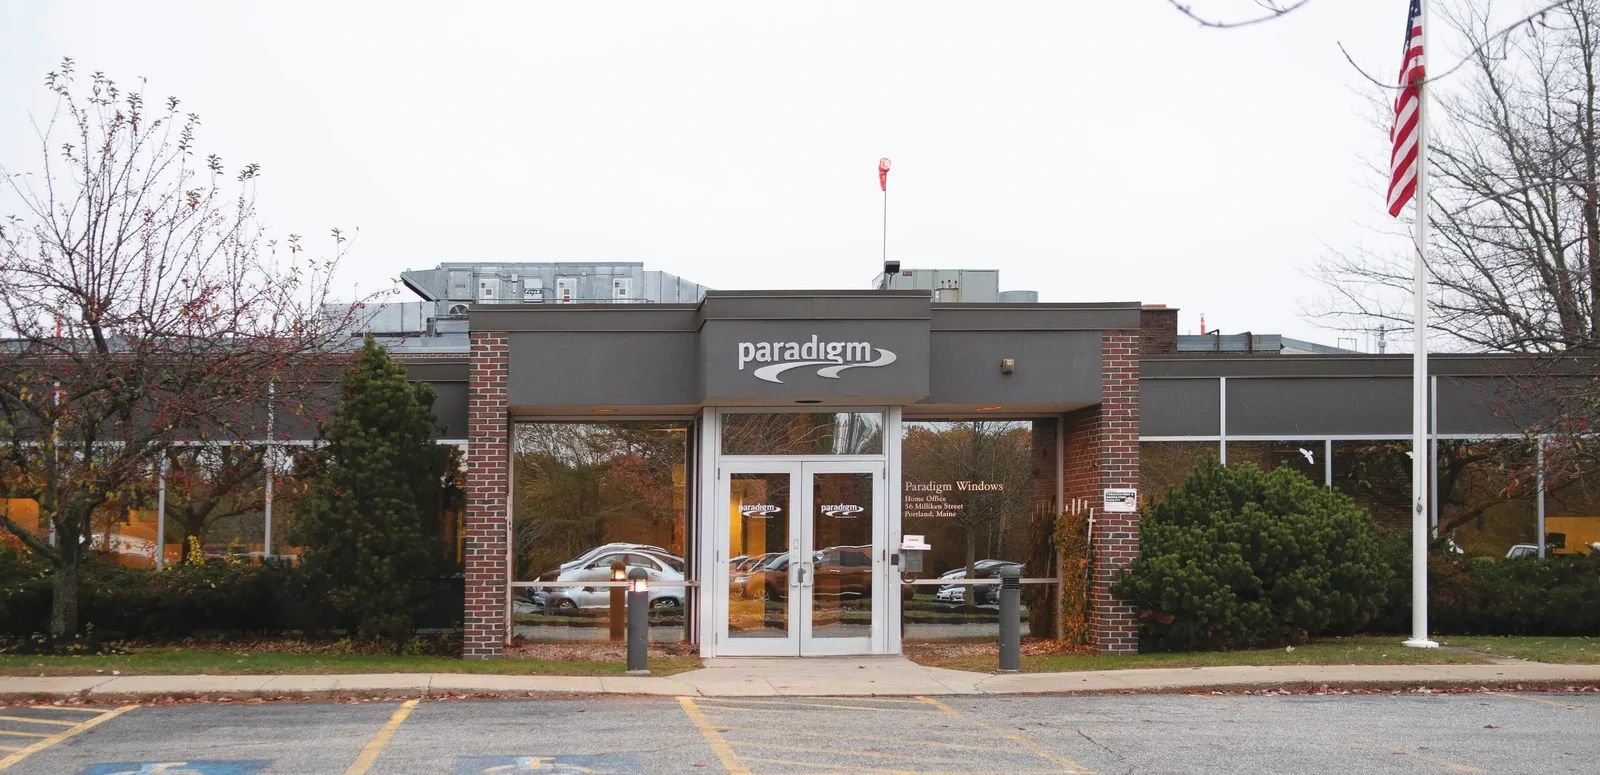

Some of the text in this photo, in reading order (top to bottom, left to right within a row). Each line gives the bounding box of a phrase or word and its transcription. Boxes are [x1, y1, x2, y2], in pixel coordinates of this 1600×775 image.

[738, 334, 871, 371] paradigm
[905, 480, 1004, 494] Paradigm Windows
[739, 503, 775, 513] paradigm
[821, 503, 858, 513] paradigm
